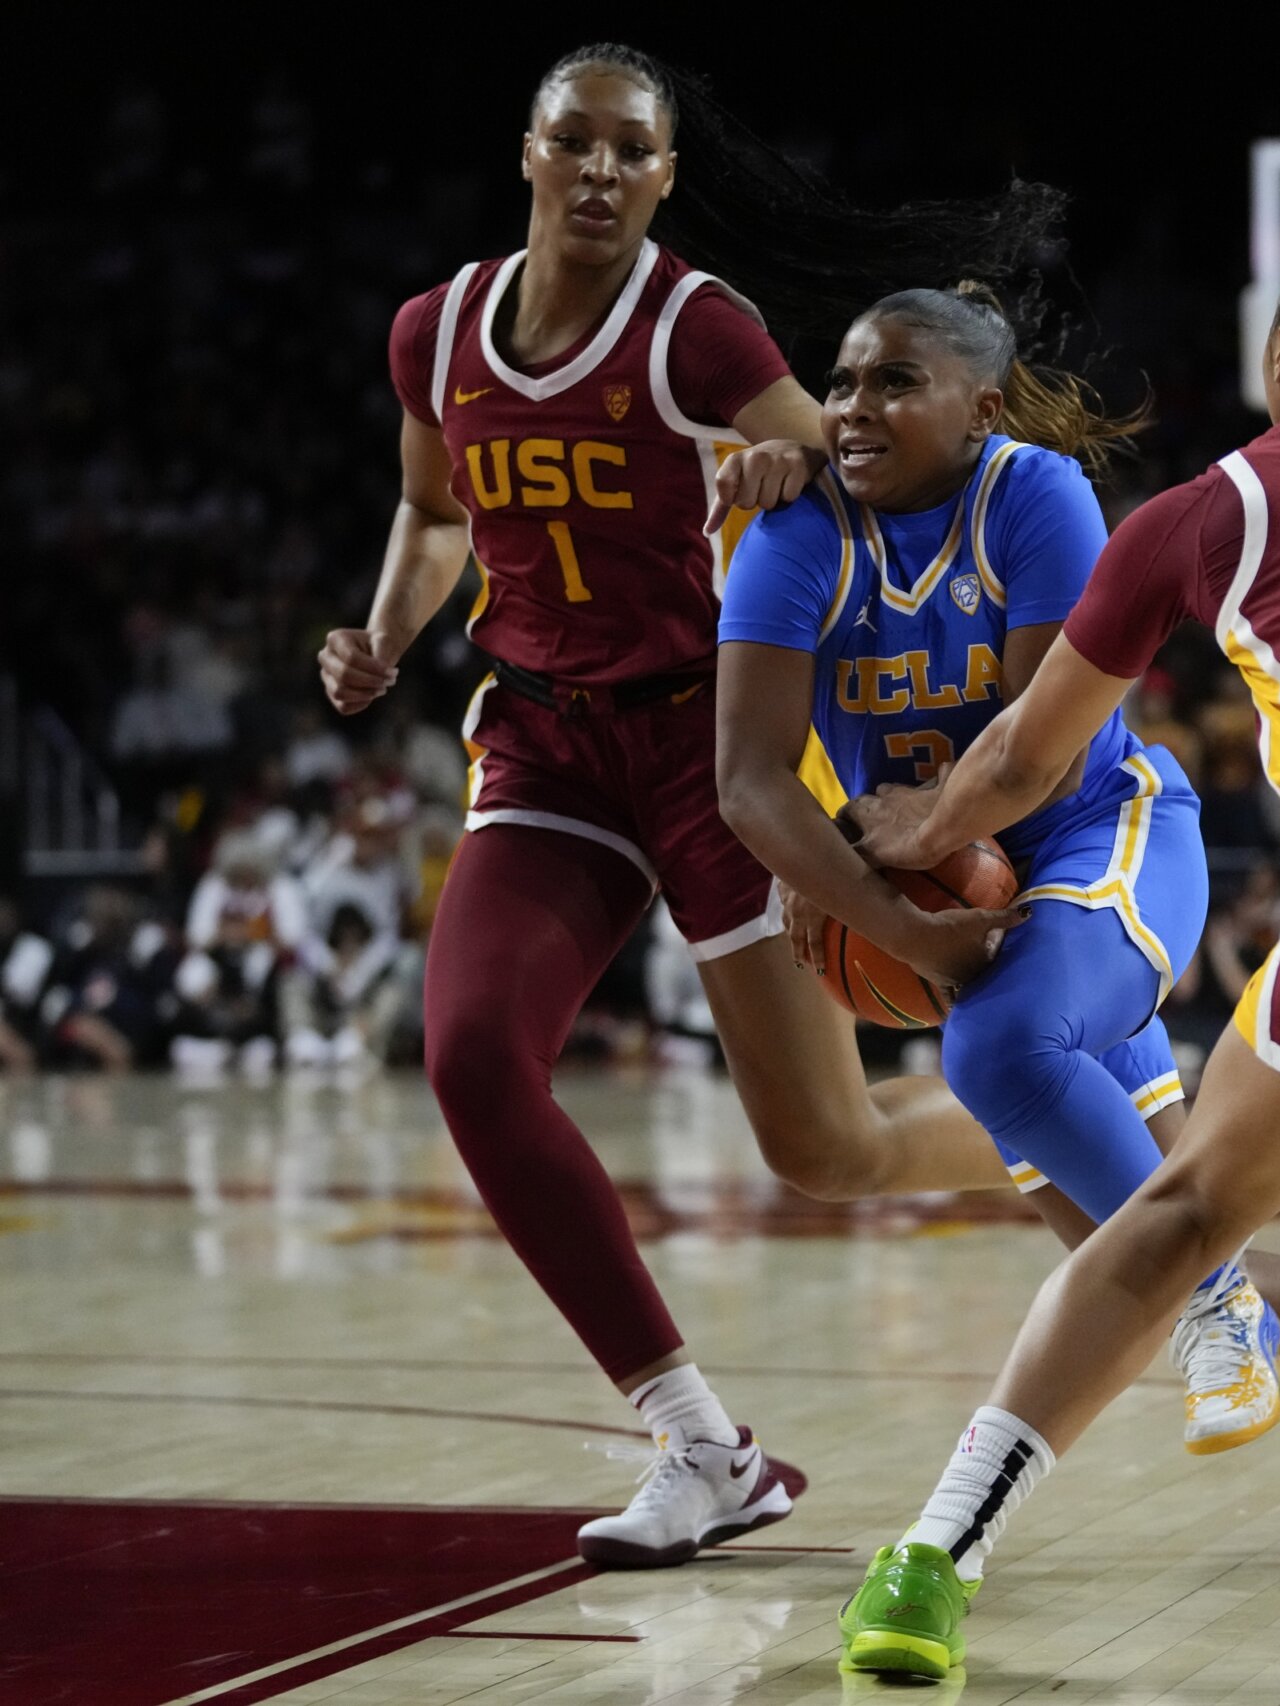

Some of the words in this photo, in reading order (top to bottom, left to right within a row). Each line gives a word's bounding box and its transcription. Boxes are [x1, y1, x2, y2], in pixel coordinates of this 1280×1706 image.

[466, 438, 634, 510] USC
[547, 521, 593, 602] 1
[961, 592, 976, 607] 12
[836, 643, 1001, 715] UCLA
